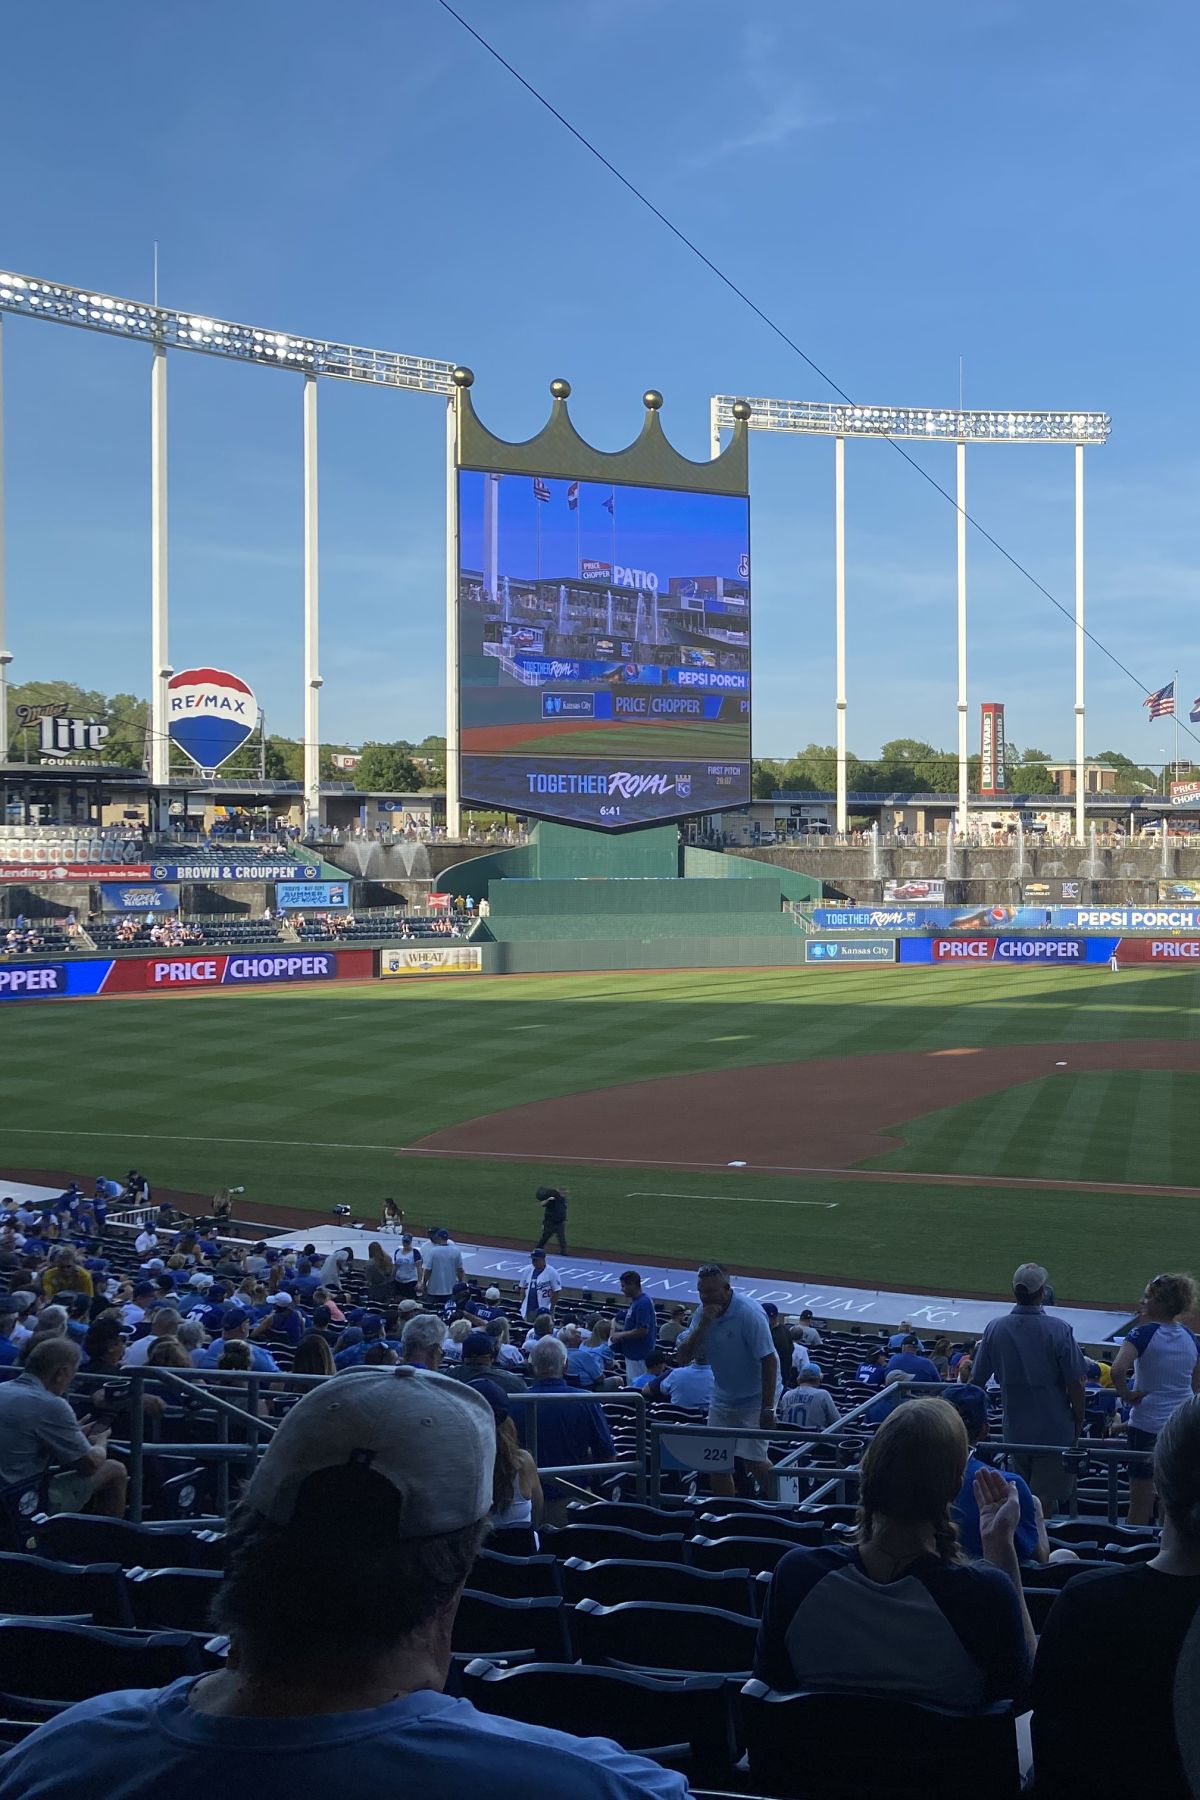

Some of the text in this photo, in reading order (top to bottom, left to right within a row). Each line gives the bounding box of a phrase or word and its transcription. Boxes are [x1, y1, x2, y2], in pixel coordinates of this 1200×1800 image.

[583, 562, 600, 570] PRICE
[583, 570, 610, 579] CHOPPER
[613, 566, 658, 591] PATIO
[550, 661, 573, 678] ROYAL
[678, 671, 745, 687] PEPSI PORCH
[172, 695, 245, 714] RE/MAX
[563, 701, 591, 710] Kansas City
[616, 697, 700, 713] PRICE CHOPPER
[38, 716, 109, 757] Lite
[983, 718, 991, 782] BOULEVARD
[40, 758, 98, 767] FOUNTAIN
[708, 766, 740, 776] FIRST PITCH
[527, 771, 675, 799] TOGETHER ROYAL
[1173, 783, 1197, 795] PRICE
[600, 806, 620, 816] 6:41
[0, 868, 47, 879] Lending
[177, 867, 295, 879] BROWN & CROUPPEN
[826, 914, 869, 925] TOGETHER
[869, 911, 907, 926] ROYAL
[1077, 912, 1192, 926] PEPSI PORCH
[841, 946, 889, 956] Kansas City
[939, 942, 1079, 957] PRICE CHOPPER
[1151, 943, 1200, 957] PRICE
[409, 952, 444, 962] WHEAT
[154, 956, 329, 982] PRICE CHOPPER
[542, 1289, 553, 1299] 20
[788, 1407, 807, 1427] 10
[704, 1449, 728, 1461] 224
